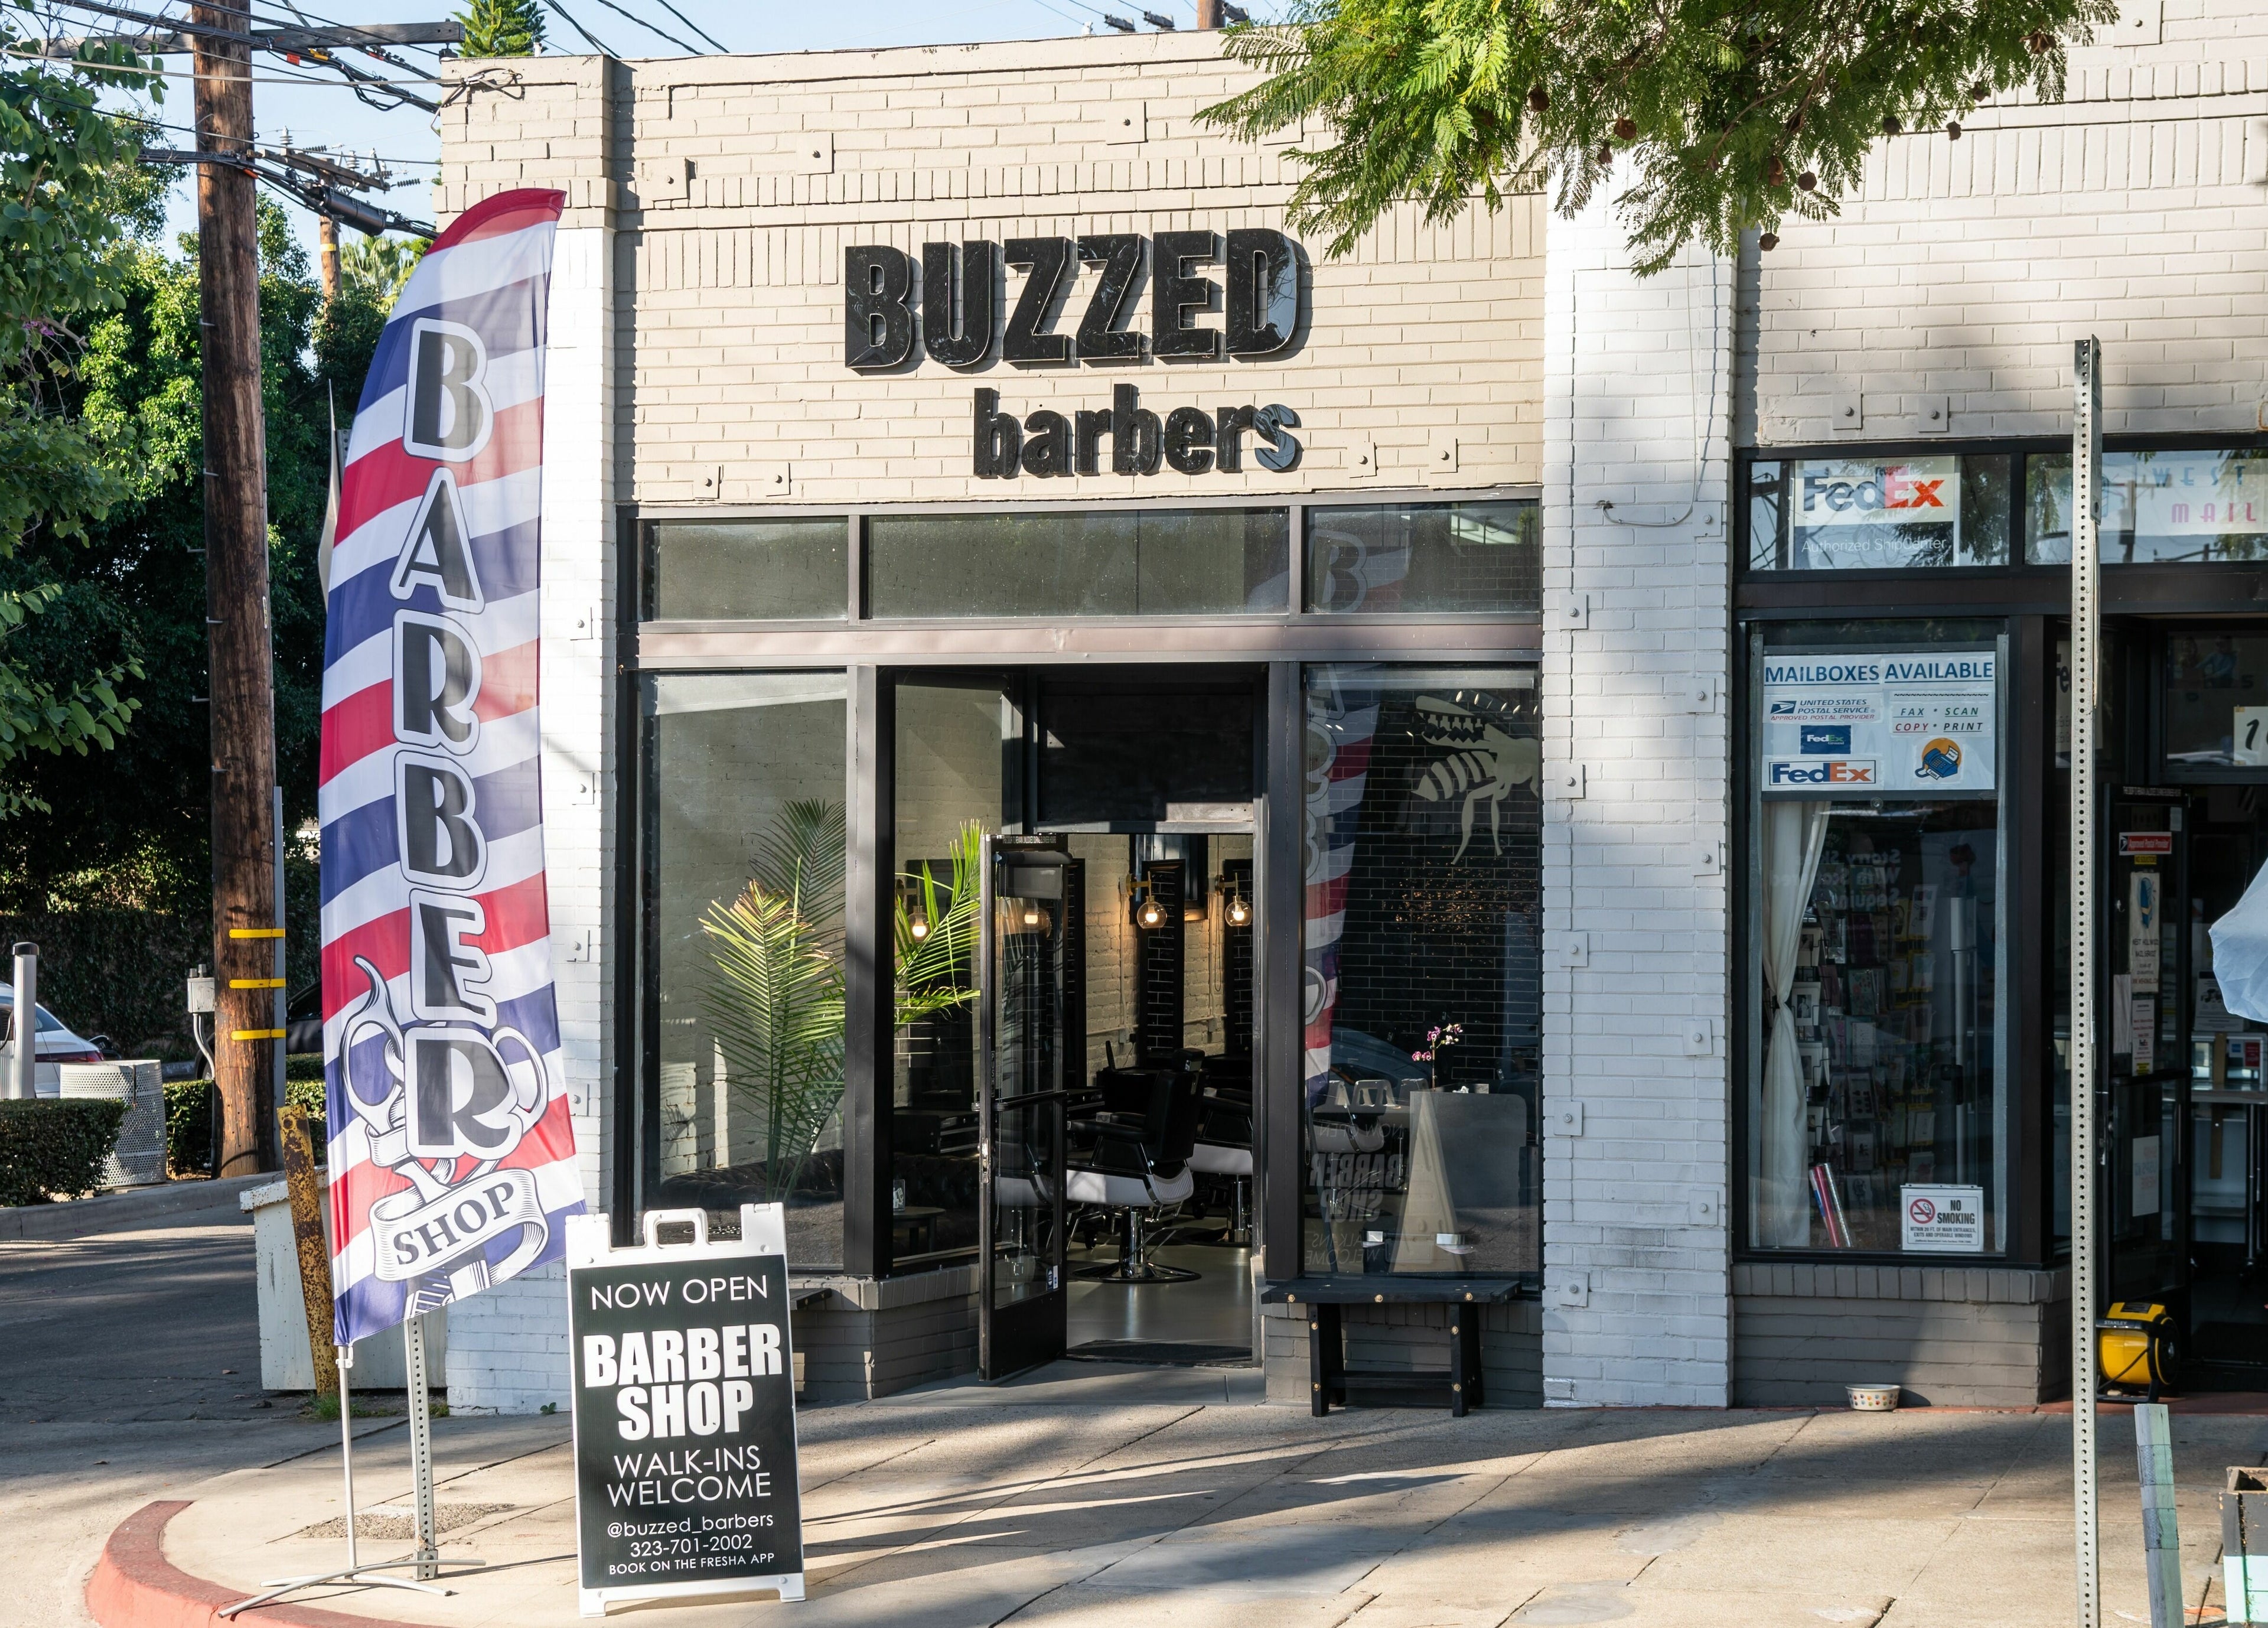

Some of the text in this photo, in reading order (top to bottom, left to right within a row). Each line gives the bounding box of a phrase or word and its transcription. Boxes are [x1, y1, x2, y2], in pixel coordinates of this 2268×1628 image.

[845, 228, 1301, 367] BUZZED
[974, 383, 1301, 480] barbers
[1804, 465, 1946, 512] FedEx
[2152, 465, 2246, 488] WEST
[2172, 502, 2257, 523] MAIL
[1801, 536, 1947, 553] Authorized ShipCenter
[1765, 662, 1993, 683] MAILBOXES AVAILABLE
[1945, 707, 1979, 715] SCAN
[391, 317, 524, 1160] BARBER
[1895, 722, 1983, 731] COPY PRINT
[1772, 763, 1872, 784] FedEx
[1950, 1200, 1961, 1211] NO
[396, 1180, 516, 1266] SHOP
[1937, 1212, 1975, 1225] SMOKING
[591, 1275, 768, 1310] NOW OPEN
[583, 1324, 783, 1388] BARBER
[617, 1380, 754, 1441] SHOP
[614, 1445, 761, 1479] WALK-INS
[607, 1472, 771, 1507] WELCOME
[607, 1512, 774, 1538] @buzzed_barbers
[630, 1533, 753, 1558] 323-701-2002
[609, 1552, 775, 1575] BOOK ON THE FRESHA APP
